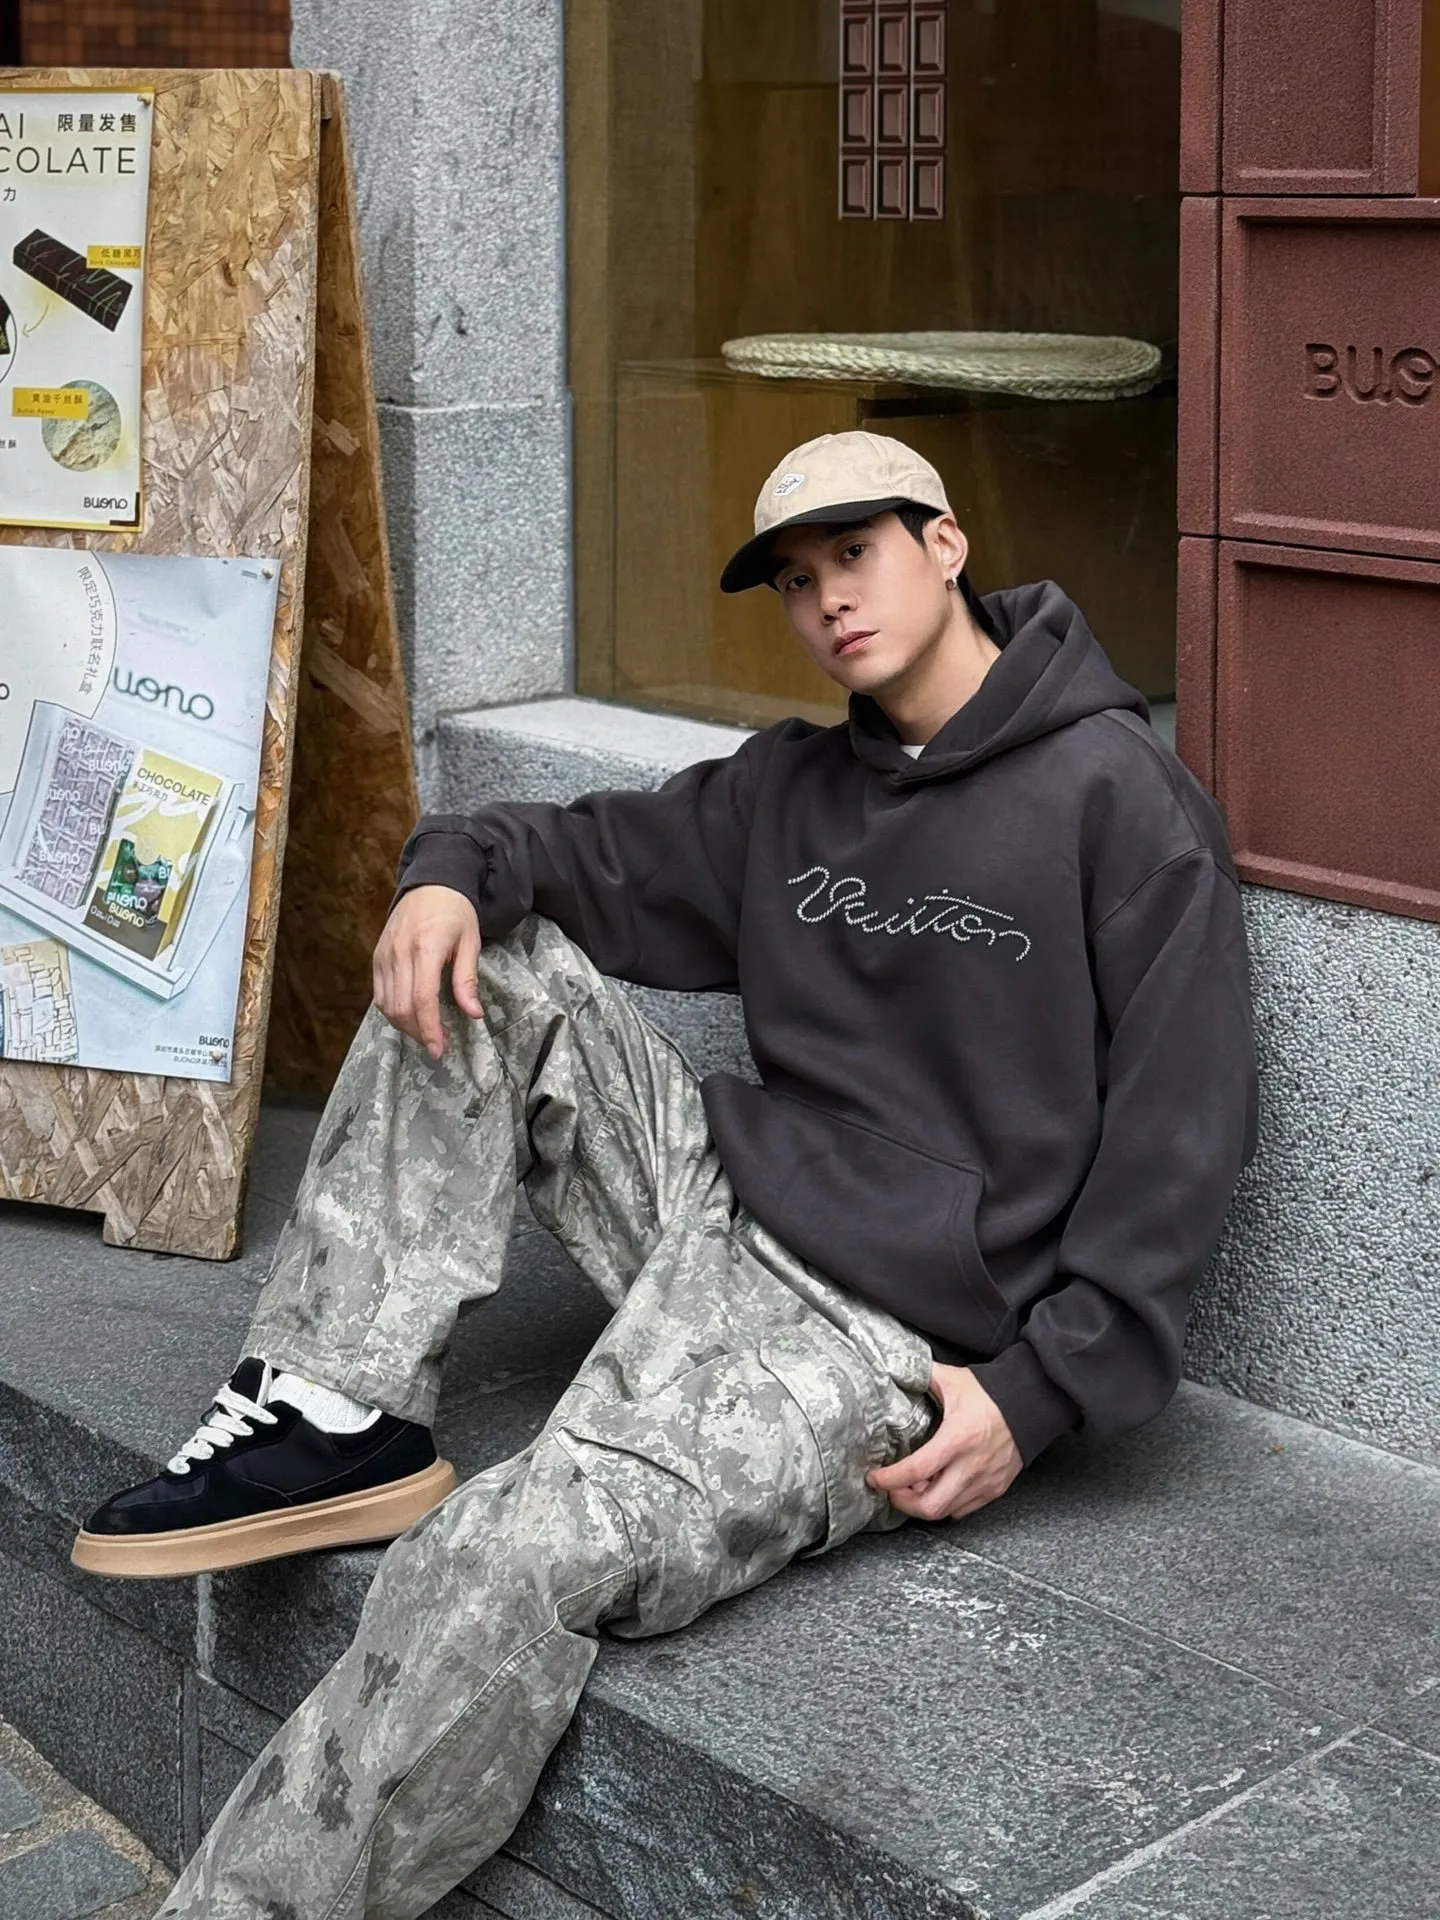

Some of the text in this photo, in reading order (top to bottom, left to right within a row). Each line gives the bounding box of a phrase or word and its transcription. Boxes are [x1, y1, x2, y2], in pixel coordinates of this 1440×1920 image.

[0, 113, 24, 139] AI
[57, 113, 136, 132] 限量发售
[3, 186, 17, 202] 力
[32, 393, 82, 405] 黄油千丝酥
[77, 566, 104, 696] 限定巧克力联名礼盒
[137, 767, 211, 807] CHOCOLATE
